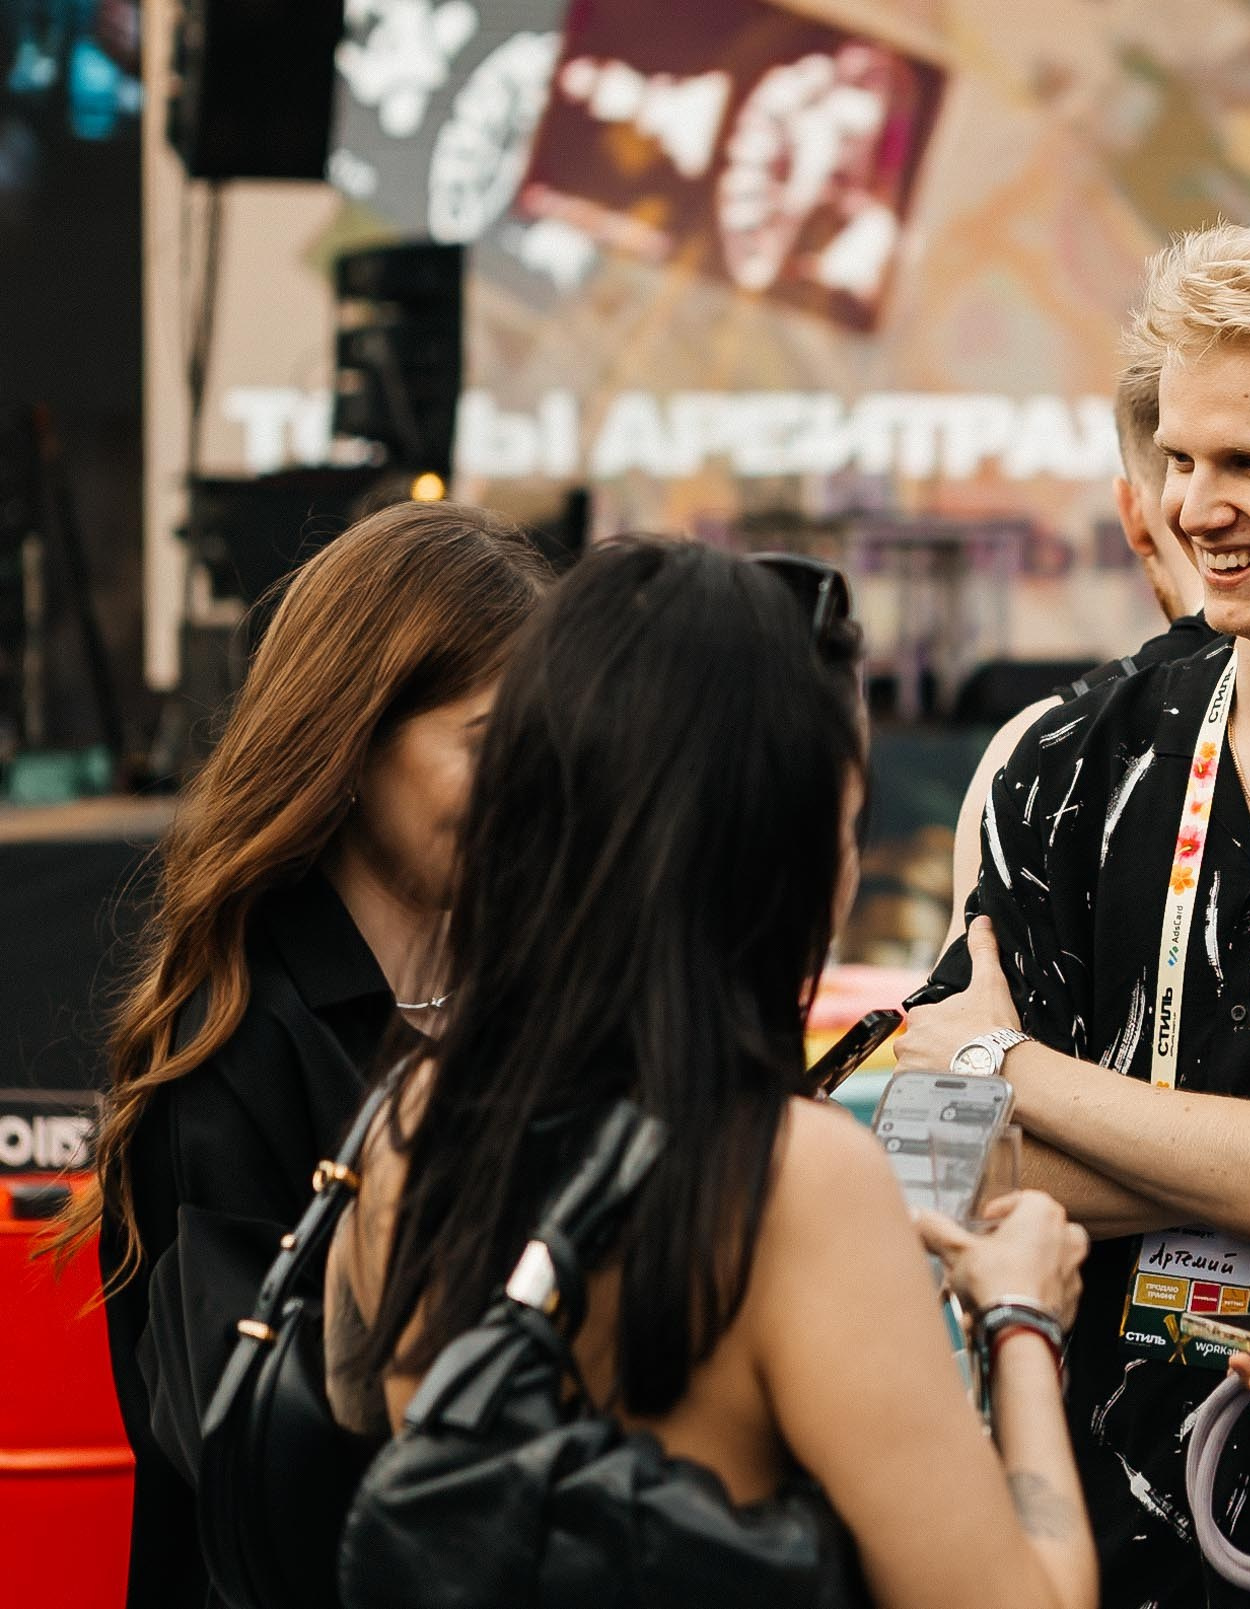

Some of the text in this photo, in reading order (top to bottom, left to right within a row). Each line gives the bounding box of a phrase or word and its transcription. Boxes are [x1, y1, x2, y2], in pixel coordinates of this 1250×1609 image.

[1171, 905, 1184, 943] AdsCard
[1157, 987, 1173, 1057] СТИЛЬ
[1148, 1242, 1238, 1275] Артемий
[1145, 1283, 1180, 1293] ПРОДАЮ
[1125, 1331, 1167, 1346] СТИЛЬ
